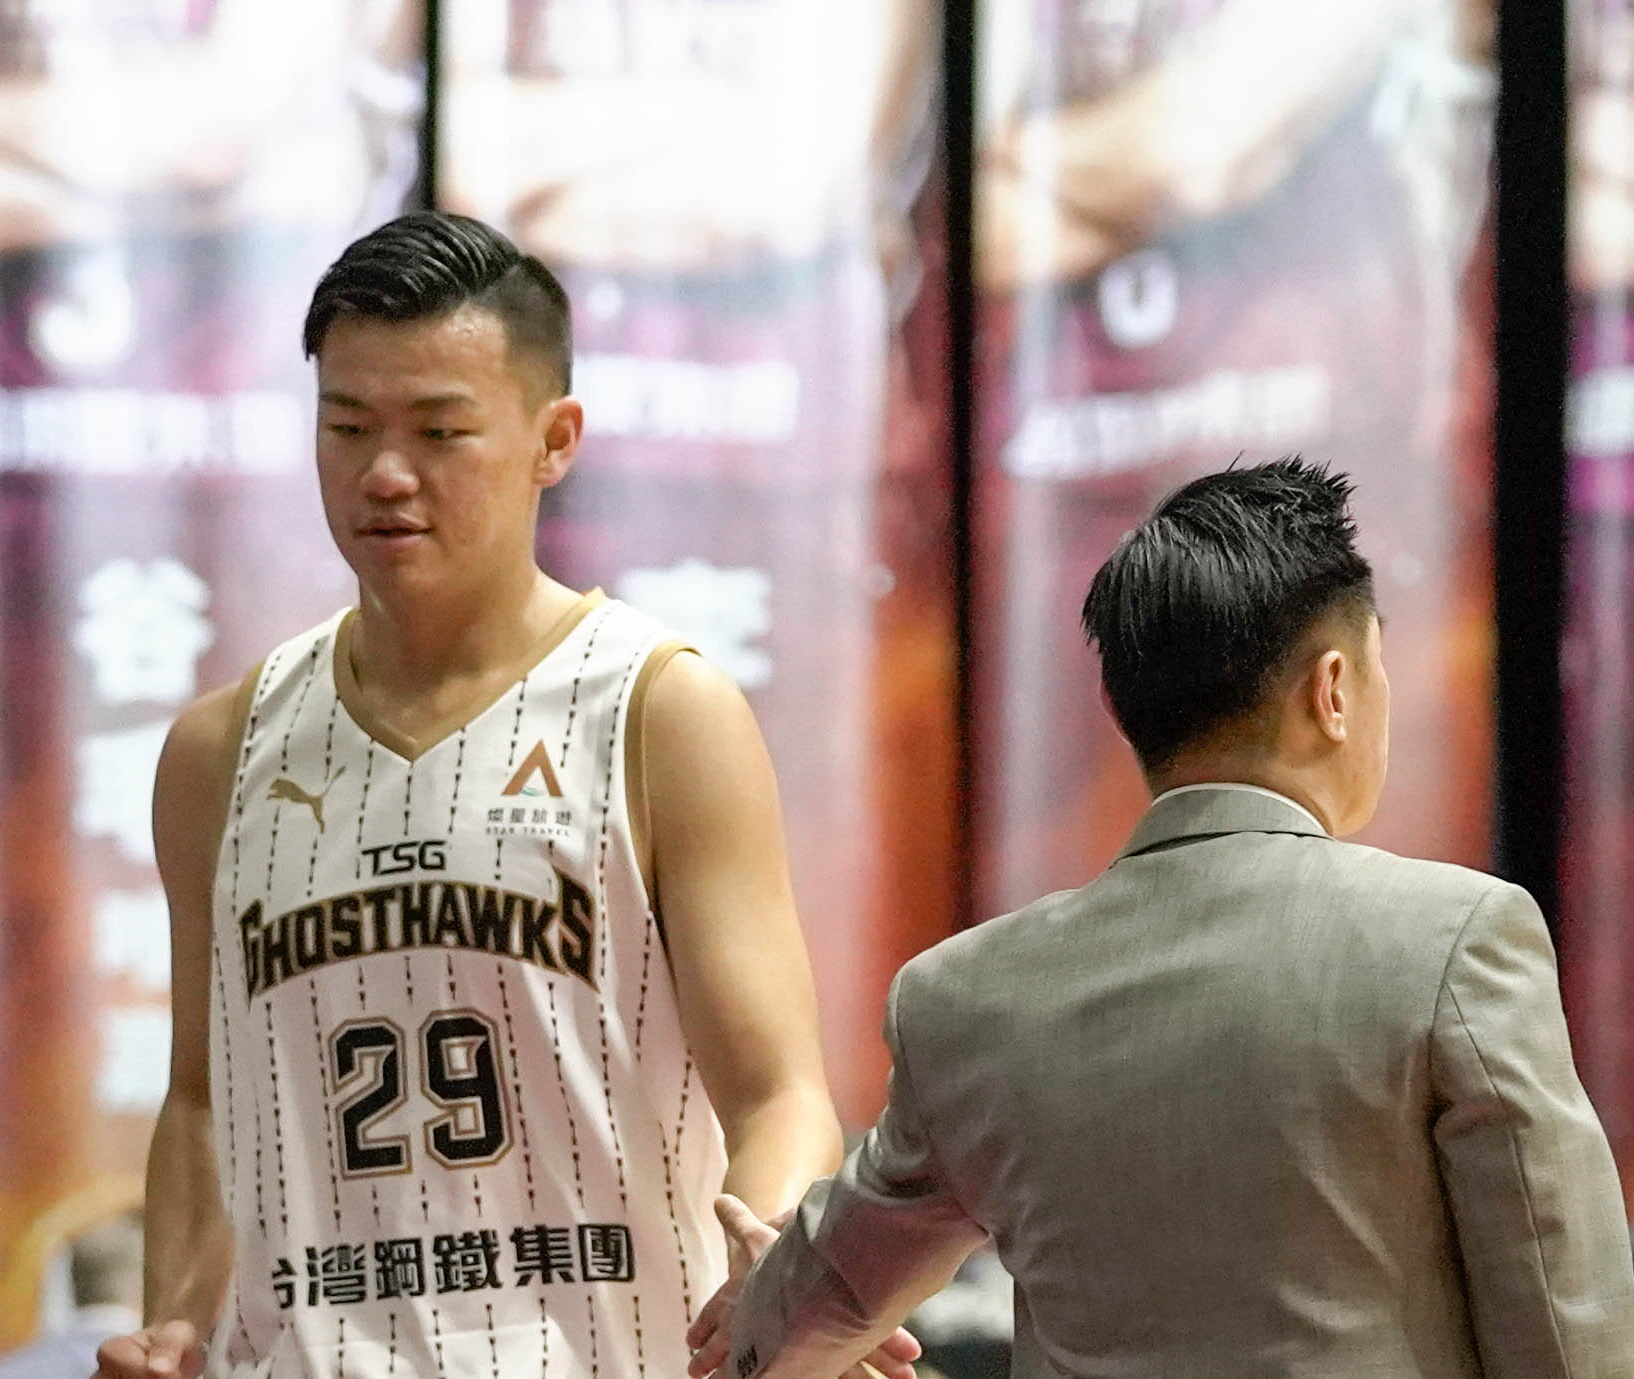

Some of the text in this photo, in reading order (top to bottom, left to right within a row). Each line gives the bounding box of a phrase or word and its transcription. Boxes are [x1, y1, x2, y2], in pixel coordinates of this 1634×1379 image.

[361, 839, 447, 878] TSG
[238, 865, 601, 1010] GHOSTHAWKS
[329, 1007, 514, 1182] 29
[271, 1223, 636, 1310] 台灣鋼鐵集團
